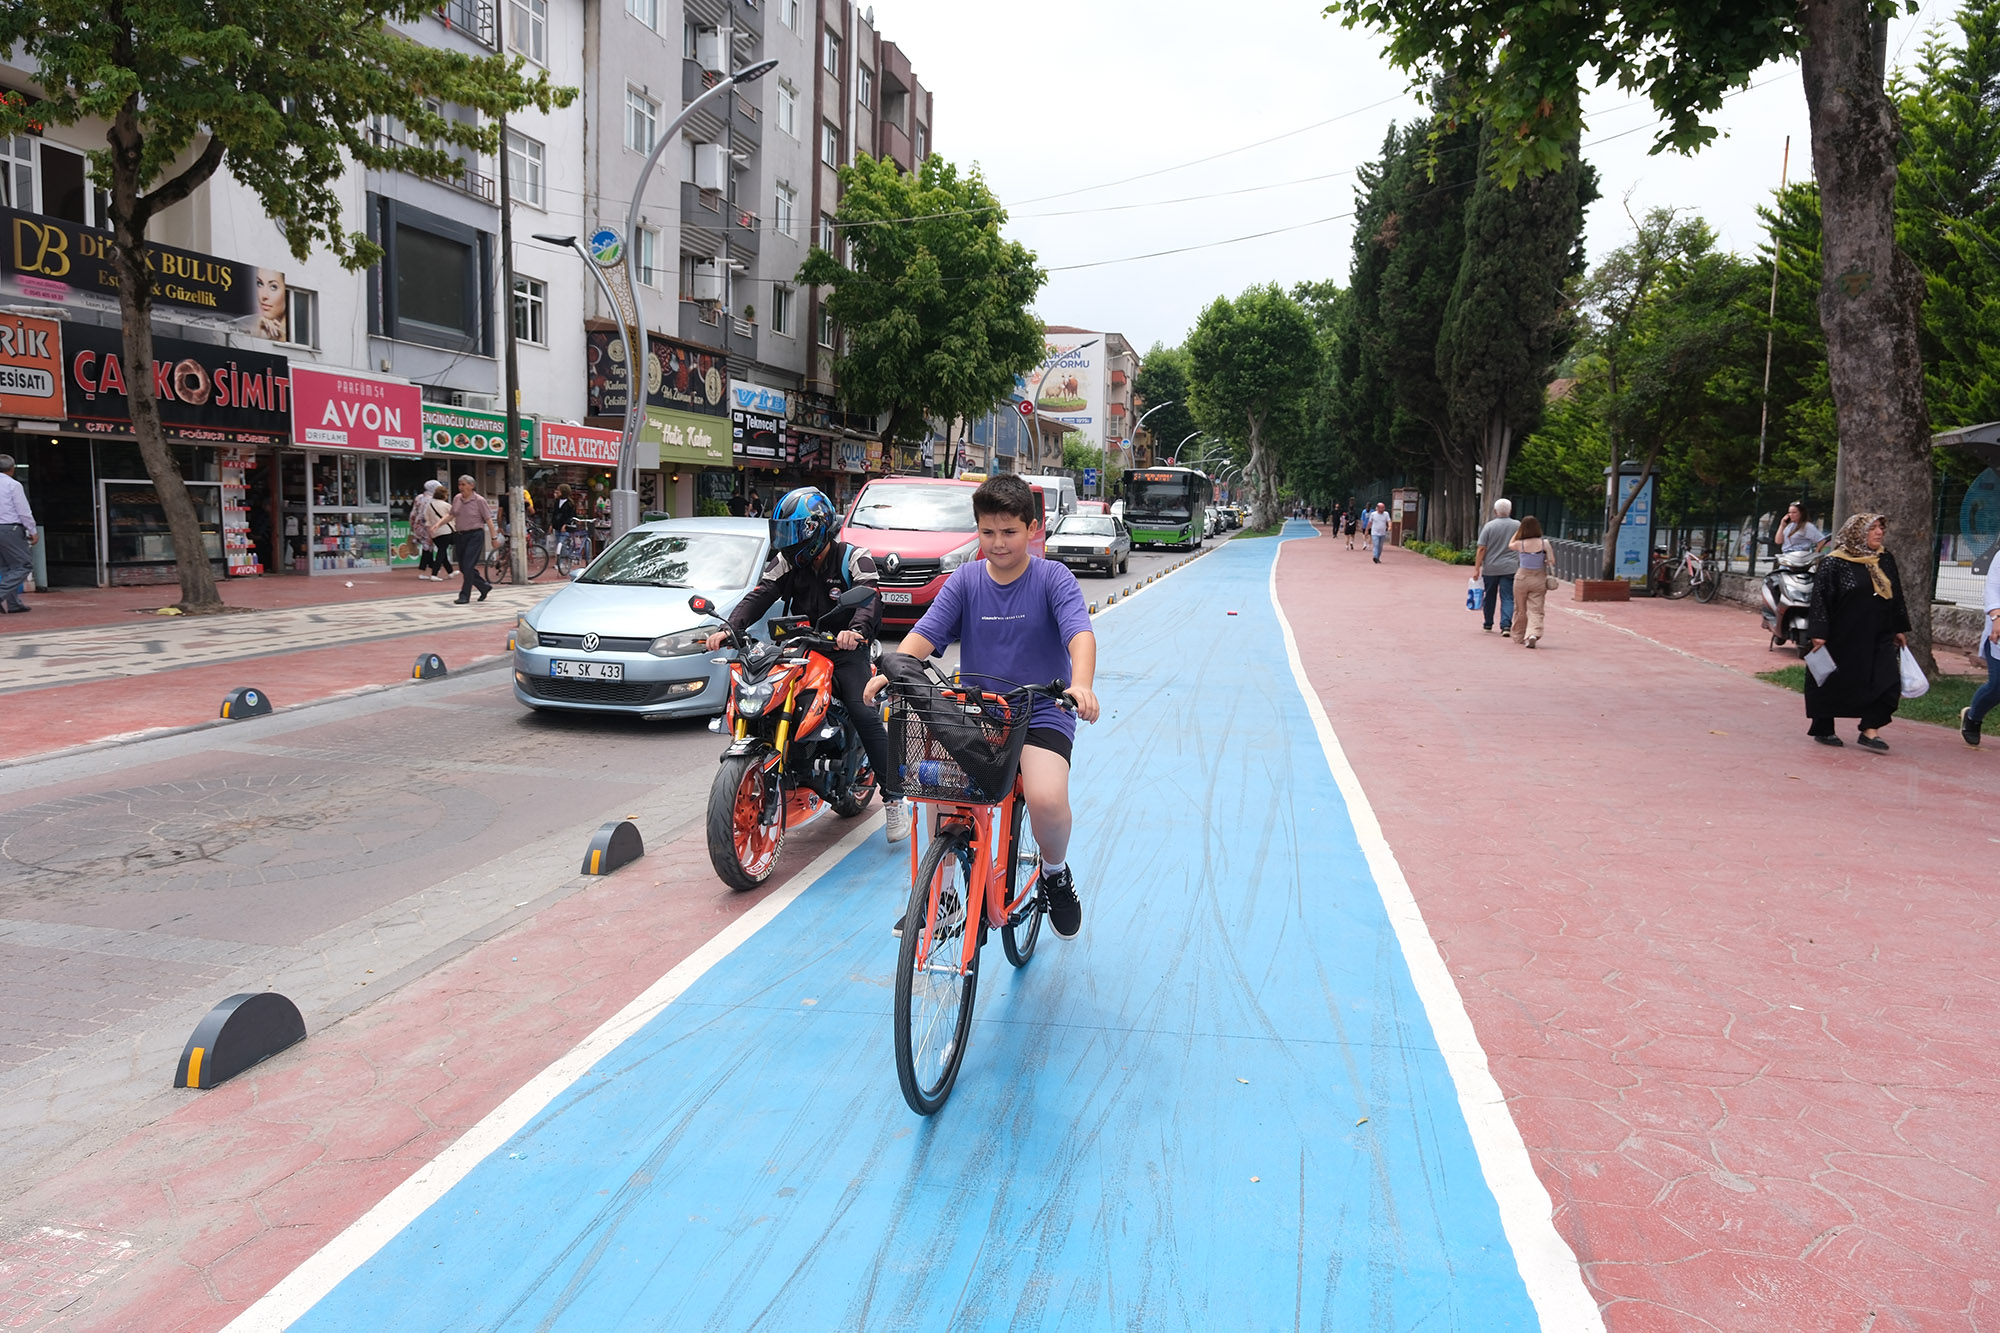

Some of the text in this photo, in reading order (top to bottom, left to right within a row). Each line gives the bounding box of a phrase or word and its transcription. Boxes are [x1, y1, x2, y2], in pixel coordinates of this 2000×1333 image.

[80, 233, 156, 271] DiK
[161, 252, 233, 292] BULUŞ
[165, 283, 217, 307] Güzellik
[1040, 360, 1090, 369] ATFORMU
[213, 361, 290, 413] SİMİT
[374, 385, 385, 399] 54
[321, 398, 402, 433] AVON
[85, 422, 114, 433] ÇAY
[465, 417, 505, 434] LOKANTASI
[745, 414, 777, 434] Teknocell
[179, 429, 225, 441] POĞAÇA
[236, 433, 271, 444] BÖREK
[306, 431, 347, 443] ORIFLAME
[547, 427, 622, 461] İKRA KIRTASİ
[236, 565, 257, 574] AVON
[890, 593, 909, 603] 0255
[557, 663, 620, 679] 54 SK 433
